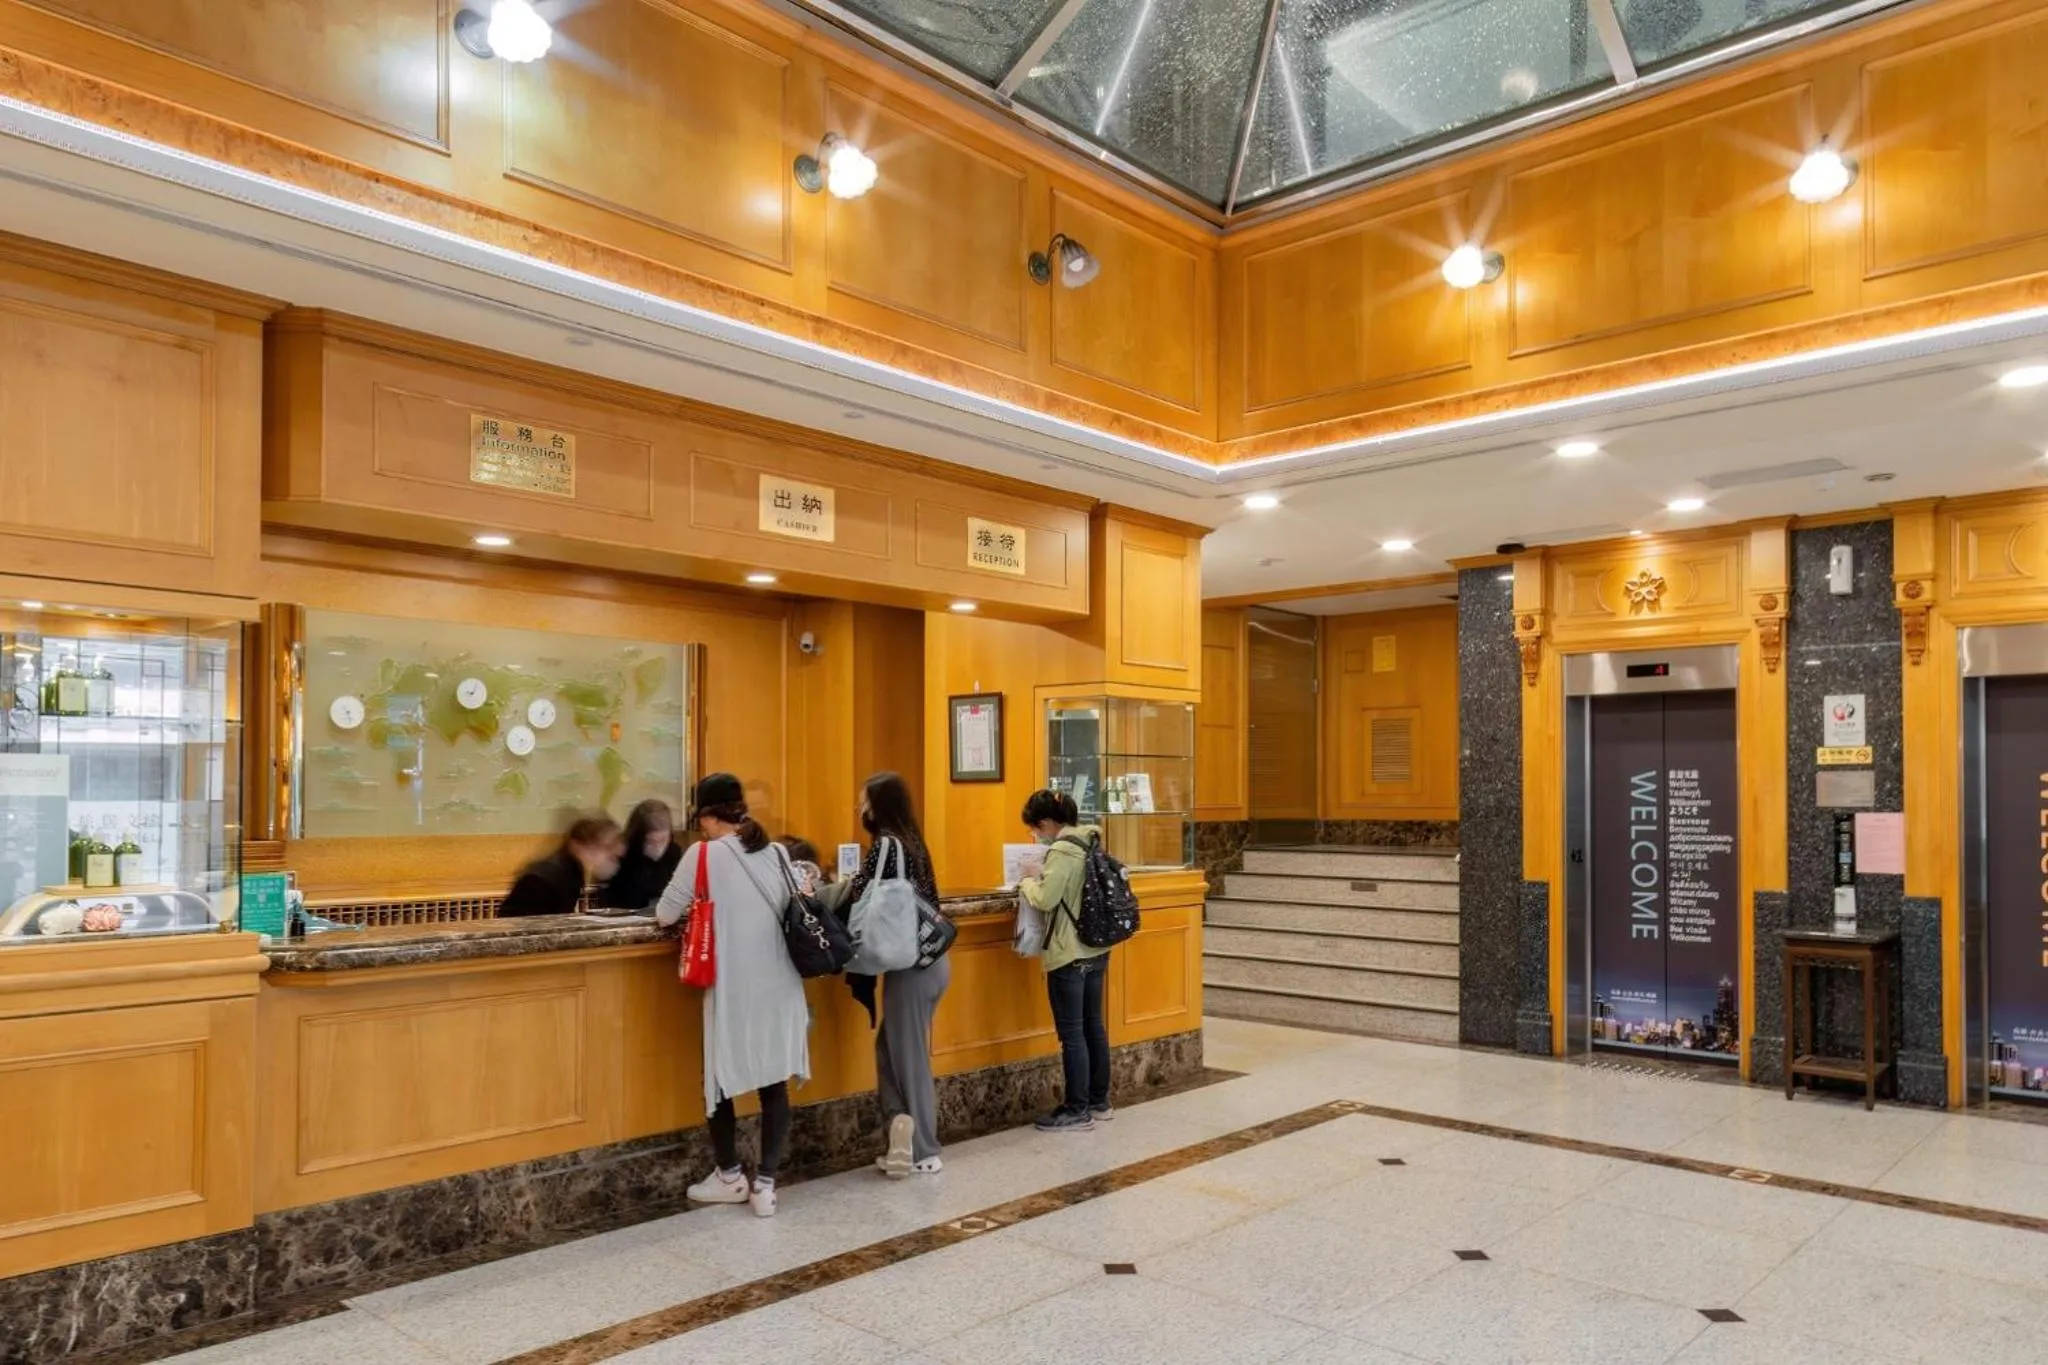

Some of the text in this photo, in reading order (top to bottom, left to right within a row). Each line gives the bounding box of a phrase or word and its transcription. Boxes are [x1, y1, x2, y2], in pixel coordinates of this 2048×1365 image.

[773, 489, 823, 516] 出納
[976, 530, 1016, 552] 接待
[973, 552, 1019, 569] RECEPTION
[1669, 806, 1699, 816] ようこそ
[1630, 770, 1658, 940] WELCOME
